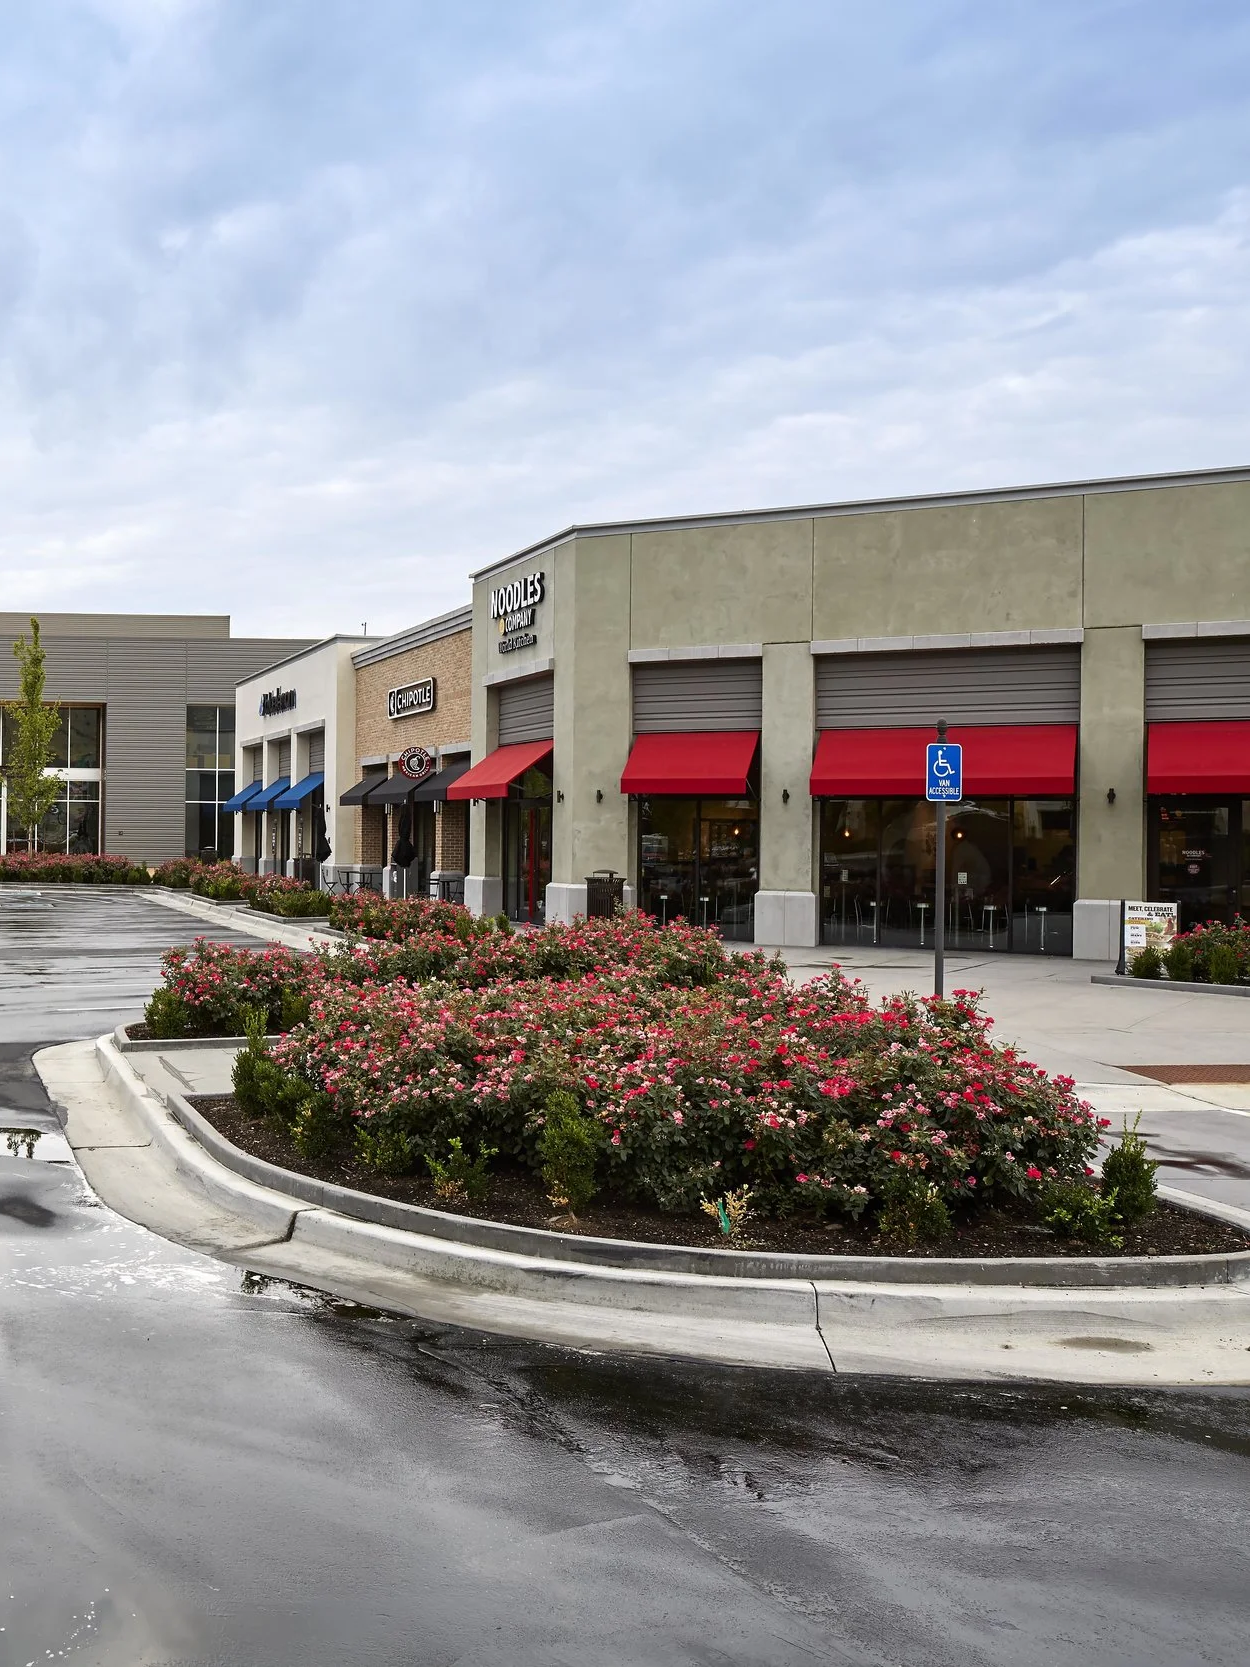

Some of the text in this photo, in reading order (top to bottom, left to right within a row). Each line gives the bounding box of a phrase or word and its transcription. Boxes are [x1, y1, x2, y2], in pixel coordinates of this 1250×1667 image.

[490, 571, 541, 619] NOODLES
[505, 608, 533, 632] COMPANY
[397, 686, 431, 709] CHIPOTLE
[401, 747, 431, 761] CHIPOTLE
[928, 787, 960, 795] ACCESSIBLE
[938, 779, 951, 787] VAN
